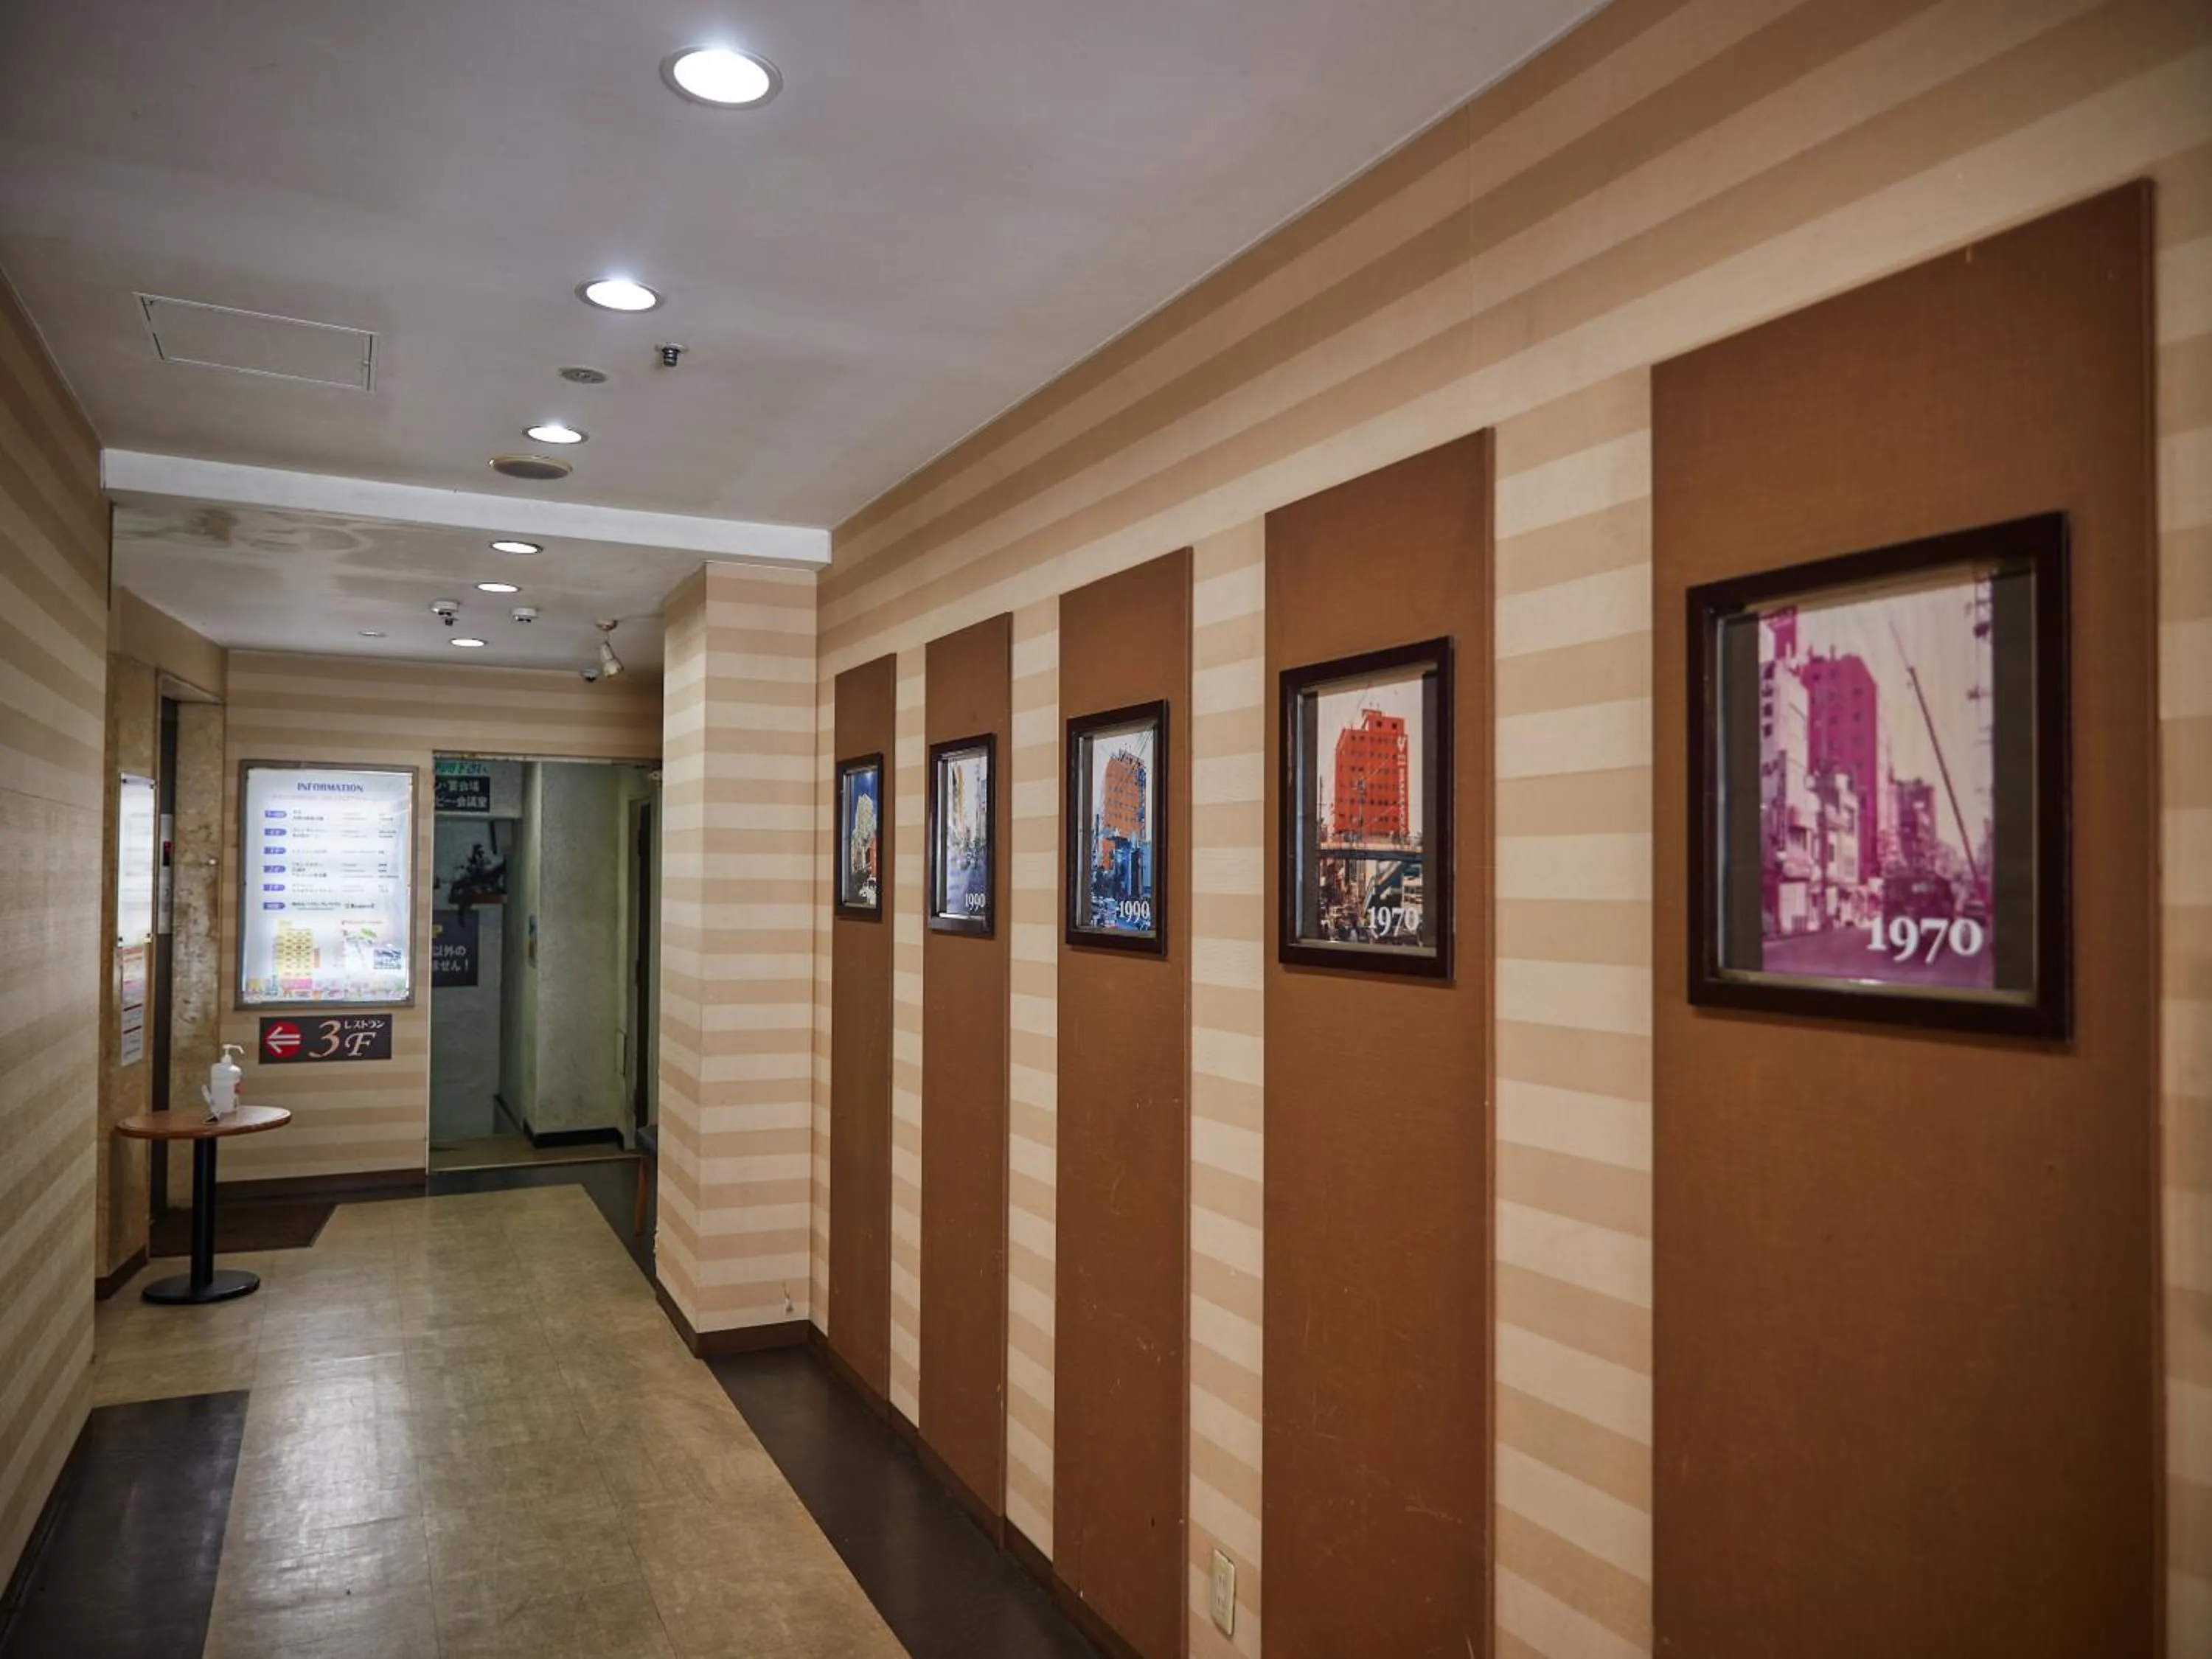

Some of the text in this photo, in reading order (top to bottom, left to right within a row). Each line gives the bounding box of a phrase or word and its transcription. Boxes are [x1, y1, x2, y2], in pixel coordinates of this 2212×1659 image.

[296, 782, 364, 793] INFORMATION
[964, 893, 986, 913] 1990
[1119, 900, 1150, 923] 1990
[1368, 906, 1419, 936] 1970
[1866, 911, 1984, 964] 1970
